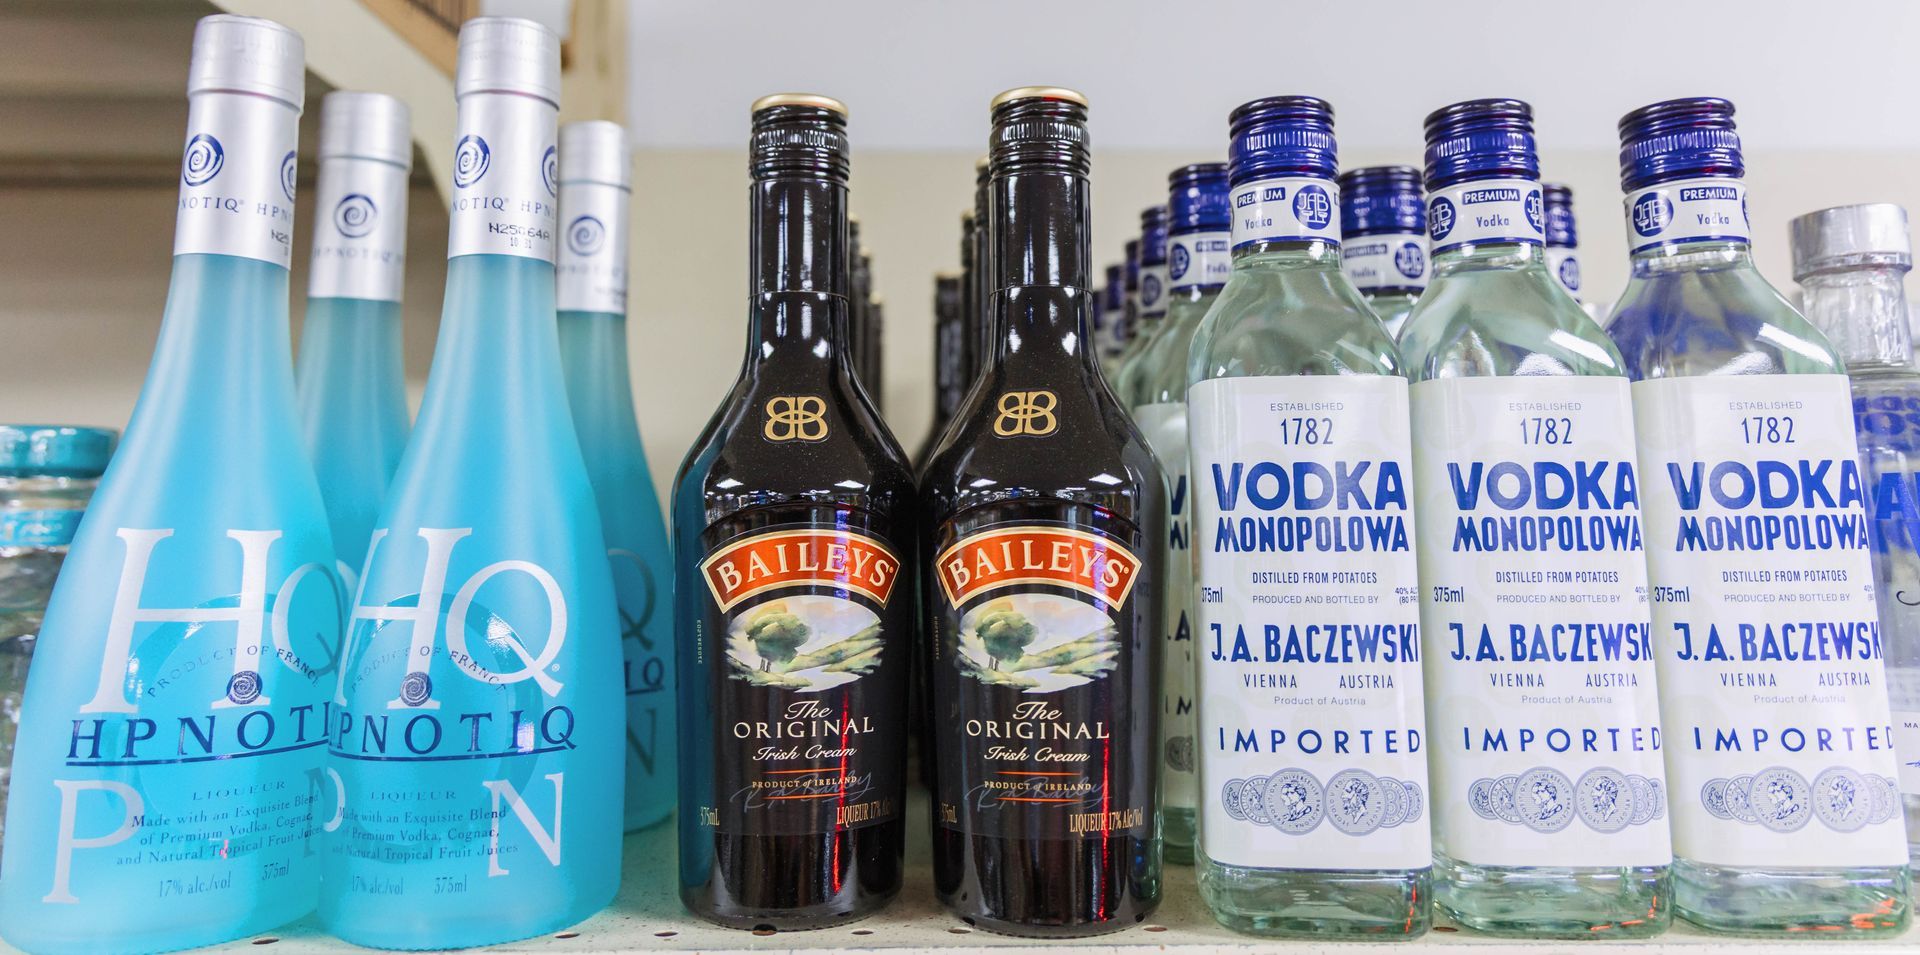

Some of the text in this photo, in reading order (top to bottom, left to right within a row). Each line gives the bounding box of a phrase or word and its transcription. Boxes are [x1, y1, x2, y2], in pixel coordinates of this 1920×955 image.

[1464, 190, 1519, 203] PREMIUM
[1683, 188, 1736, 200] PREMIUM
[1476, 215, 1510, 228] Vodka
[1697, 211, 1730, 225] Vodka
[1270, 402, 1344, 412] ESTABLISHED
[1509, 402, 1582, 411] ESTABLISHED
[1729, 401, 1803, 411] ESTABLISHED
[1280, 417, 1334, 445] 1782
[1519, 417, 1573, 445] 1782
[1741, 416, 1796, 444] 1782
[1211, 460, 1408, 512] VODKA
[1446, 460, 1640, 511] VODKA
[1666, 459, 1864, 511] VODKA
[1214, 515, 1410, 553] MONOPOLOWA
[1452, 515, 1643, 552] MONOPOLOWA
[1675, 514, 1870, 552] MONOPOLOWA
[715, 541, 891, 594] BAILEYS
[947, 538, 1125, 591] BAILEYS
[1252, 571, 1378, 584] DISTILLED FROM POTATOES
[1495, 570, 1619, 583] DISTILLED FROM POTATOES
[1722, 569, 1848, 583] DISTILLED FROM POTATOES
[1252, 595, 1379, 604] PRODUCED AND BOTTLED BY
[1433, 586, 1465, 603] 375ml
[1496, 594, 1621, 603] PRODUCED AND BOTTLED BY
[1654, 586, 1691, 603] 375ml
[1724, 592, 1851, 603] PRODUCED AND BOTTLED BY
[246, 645, 269, 656] OF
[420, 645, 442, 657] OF
[1264, 623, 1419, 663] BACZEWSKI
[1509, 622, 1653, 662] BACZEWSK
[1738, 621, 1883, 662] BACZEWSK
[1243, 673, 1298, 688] VIENNA
[1339, 674, 1394, 689] AUSTRIA
[1490, 673, 1545, 687] VIENNA
[1585, 673, 1638, 687] AUSTRIA
[1720, 673, 1777, 687] VIENNA
[1818, 672, 1871, 687] AUSTRIA
[1274, 696, 1367, 706] Product of Austria
[1521, 695, 1613, 704] Product of Austria
[1753, 694, 1847, 704] Product of Austria
[784, 700, 833, 721] The
[1012, 701, 1063, 721] The
[66, 701, 330, 759] HPNOTI
[733, 716, 875, 740] ORIGINAL
[965, 719, 1110, 740] ORIGINAL
[1219, 727, 1421, 754] IMPORTED
[1463, 726, 1661, 752] IMPORTED
[752, 744, 859, 762] Irish Cream
[983, 745, 1091, 763] Irish Cream
[192, 780, 286, 801] LIQUEUR
[752, 779, 800, 789] PRODUCT
[814, 775, 858, 787] IRELAND
[984, 780, 1031, 791] PRODUCT
[1045, 783, 1092, 792] IRELAND
[370, 790, 457, 803] LIQUEUR
[132, 790, 319, 828] Made with an Exquisite Blend
[361, 809, 382, 823] with
[386, 814, 399, 823] an
[404, 810, 464, 827] Exquisite
[470, 805, 507, 821] Blend
[836, 802, 869, 828] LIQUEUR
[140, 833, 154, 846] of
[160, 828, 223, 845] Premium
[230, 820, 272, 837] Vodka,
[1069, 813, 1106, 837] LIQUEUR
[1108, 810, 1121, 831] 17%
[352, 826, 395, 841] Premium
[400, 828, 441, 842] Vodka,
[447, 827, 499, 843] Cognac,
[116, 850, 142, 866] and
[149, 844, 204, 864] Natural
[210, 836, 264, 858] Tropical
[269, 832, 295, 847] Fruit
[384, 846, 433, 864] Tropical
[438, 846, 472, 860] Fruit
[477, 843, 519, 856] Juices
[262, 857, 290, 881] 375ml
[160, 879, 184, 899] 17%
[433, 873, 467, 895] 375ml
